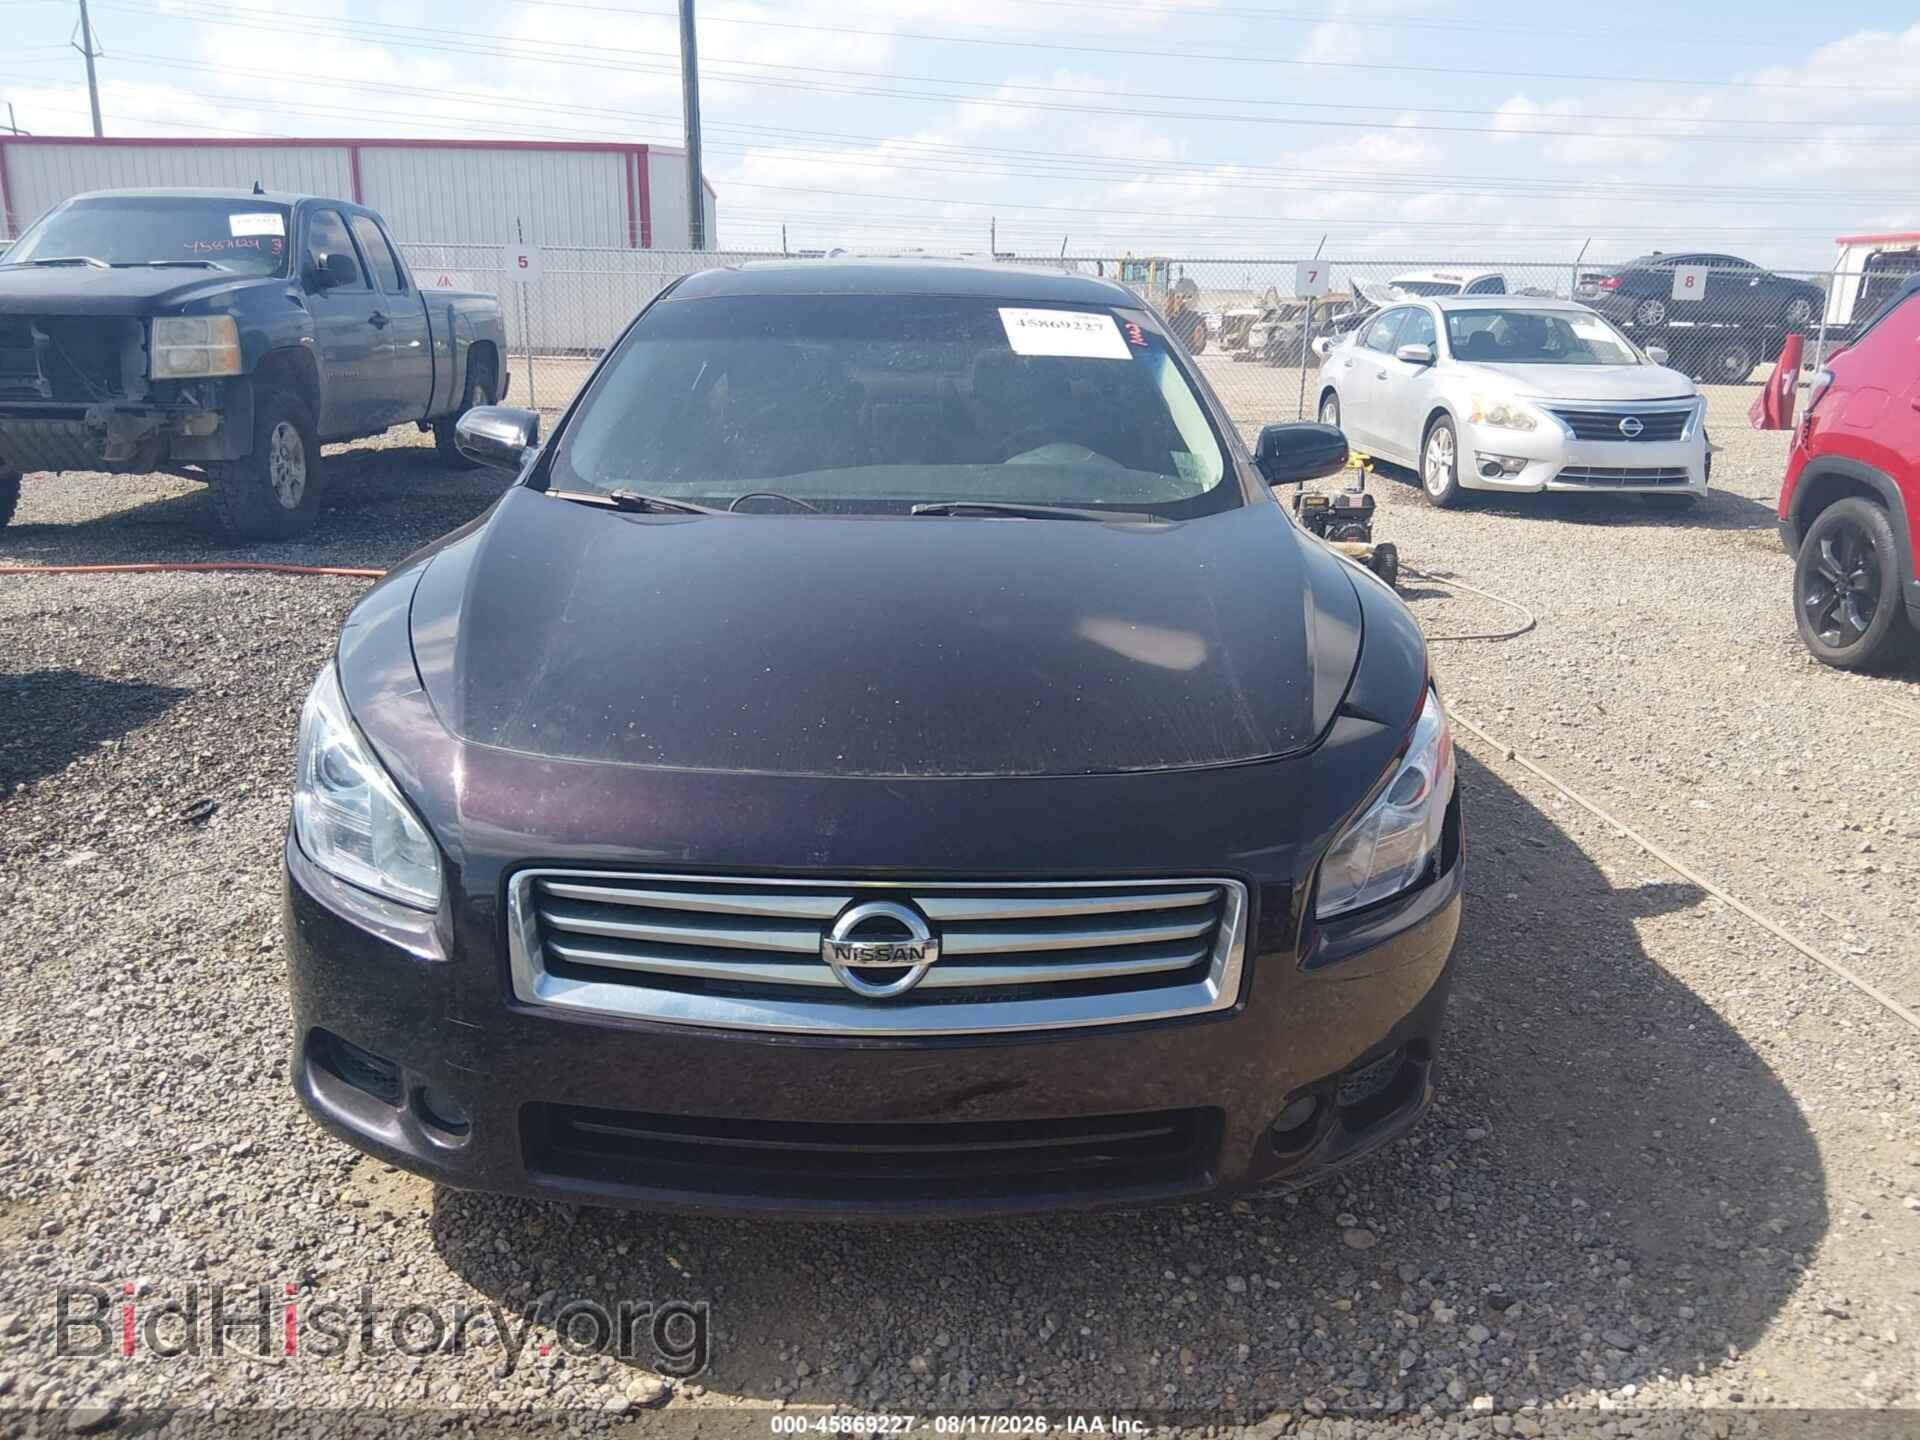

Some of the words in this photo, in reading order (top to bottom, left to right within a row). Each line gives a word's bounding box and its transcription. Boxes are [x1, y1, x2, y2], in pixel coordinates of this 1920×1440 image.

[517, 255, 529, 269] 5
[1308, 270, 1318, 284] 7
[1684, 275, 1695, 288] 8
[1016, 318, 1104, 332] 45869227
[834, 946, 926, 962] NISSAN
